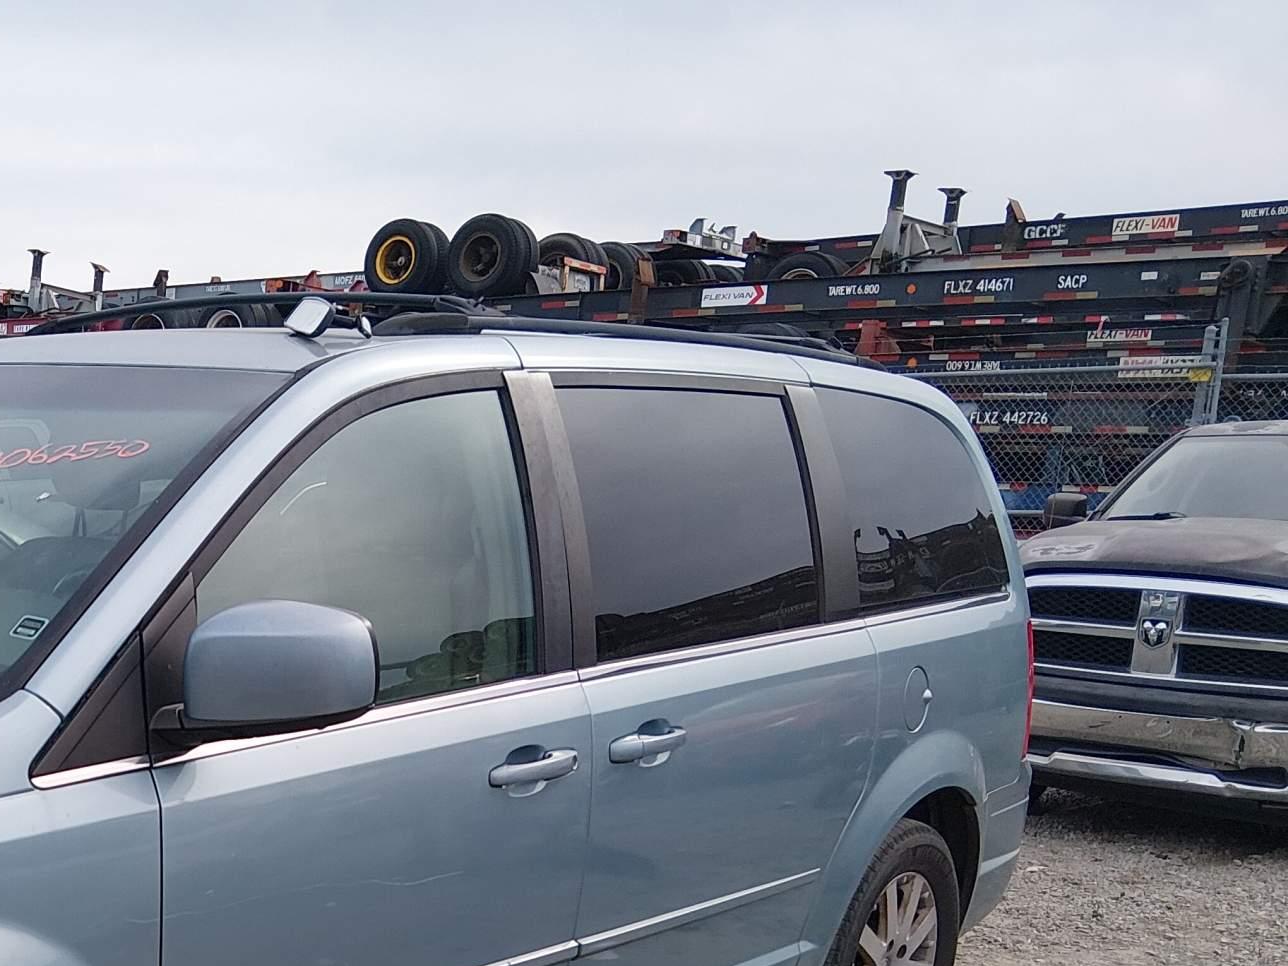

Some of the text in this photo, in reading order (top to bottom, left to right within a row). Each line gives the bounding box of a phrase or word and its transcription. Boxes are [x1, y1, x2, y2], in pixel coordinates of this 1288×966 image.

[1113, 217, 1178, 233] FLEXI-VAN
[943, 278, 1014, 294] FLXZ 414671
[1057, 274, 1088, 289] SACP
[969, 411, 1049, 425] FLXZ 442726
